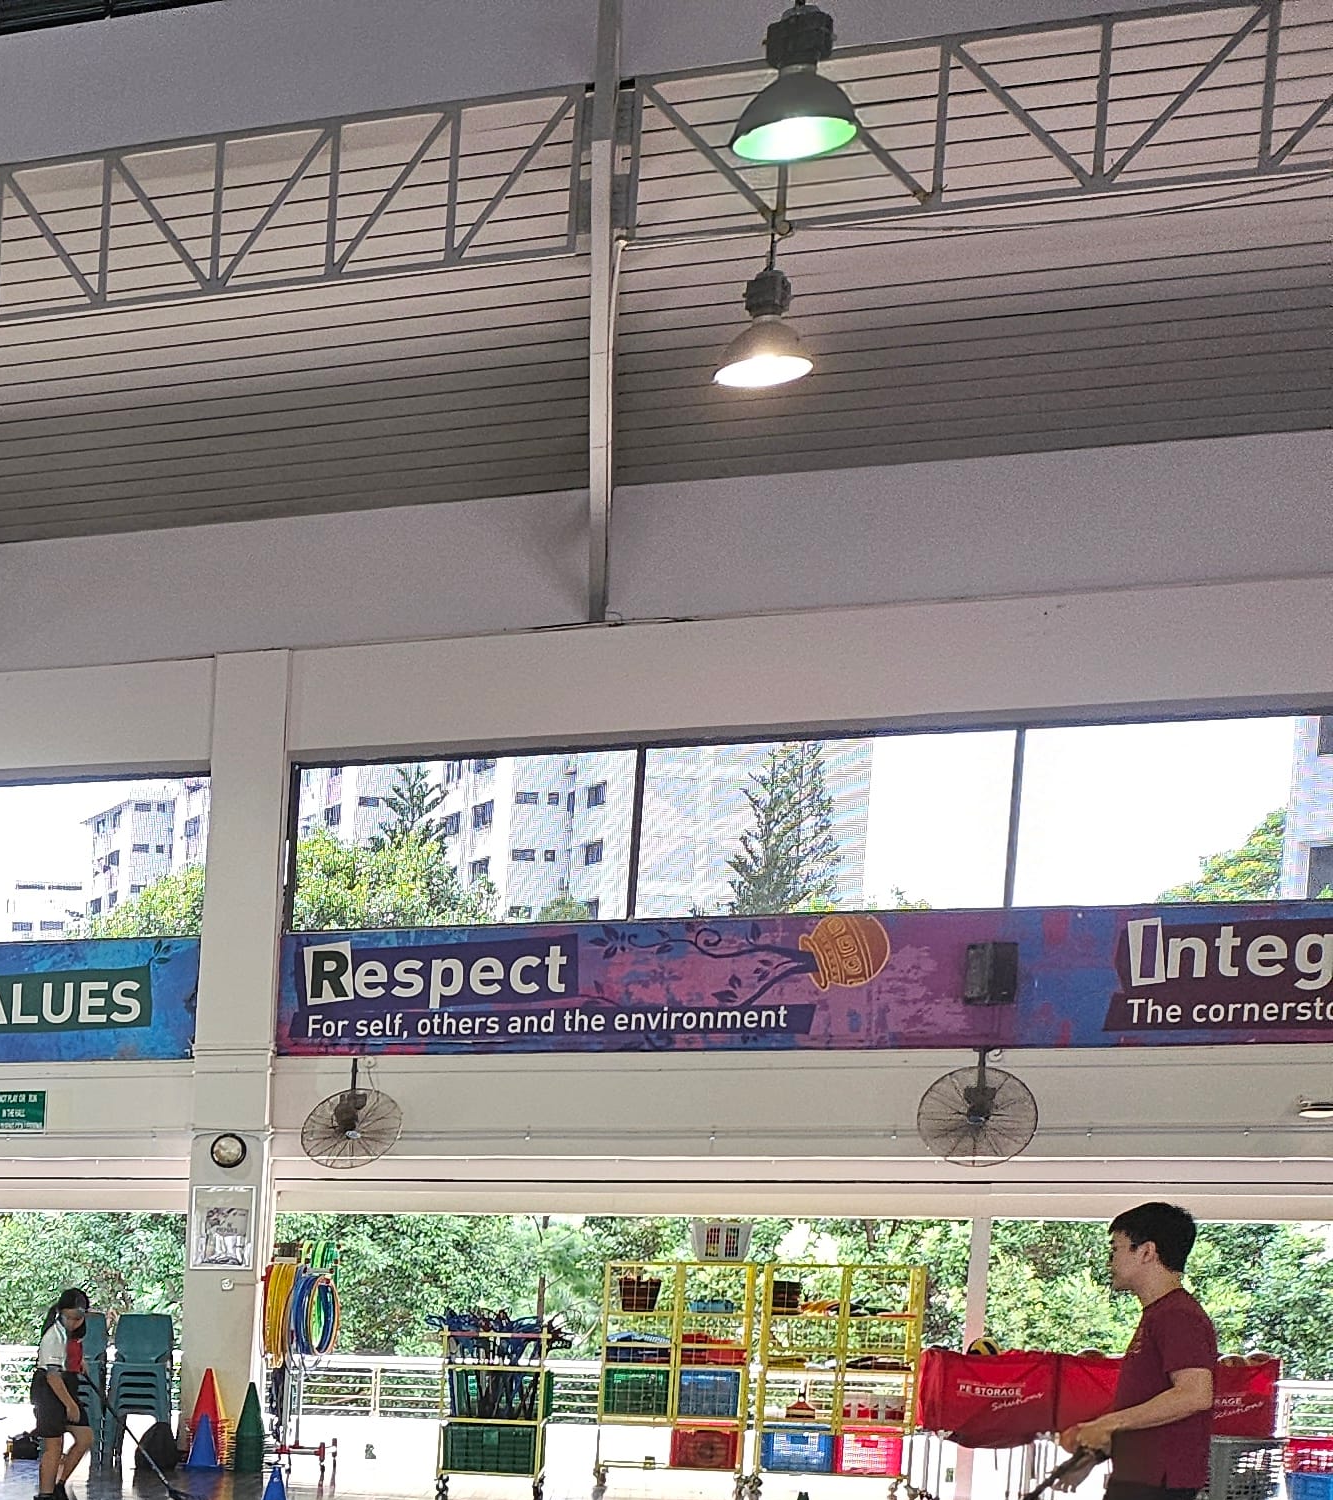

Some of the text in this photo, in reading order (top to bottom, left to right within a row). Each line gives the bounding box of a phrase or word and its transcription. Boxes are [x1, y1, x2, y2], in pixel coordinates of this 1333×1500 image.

[305, 943, 568, 1009] Respect
[307, 1006, 788, 1041] For self, others and the environment
[1127, 998, 1182, 1024] The
[959, 1384, 1022, 1396] PE STORAGE
[991, 1391, 1045, 1411] Solutions
